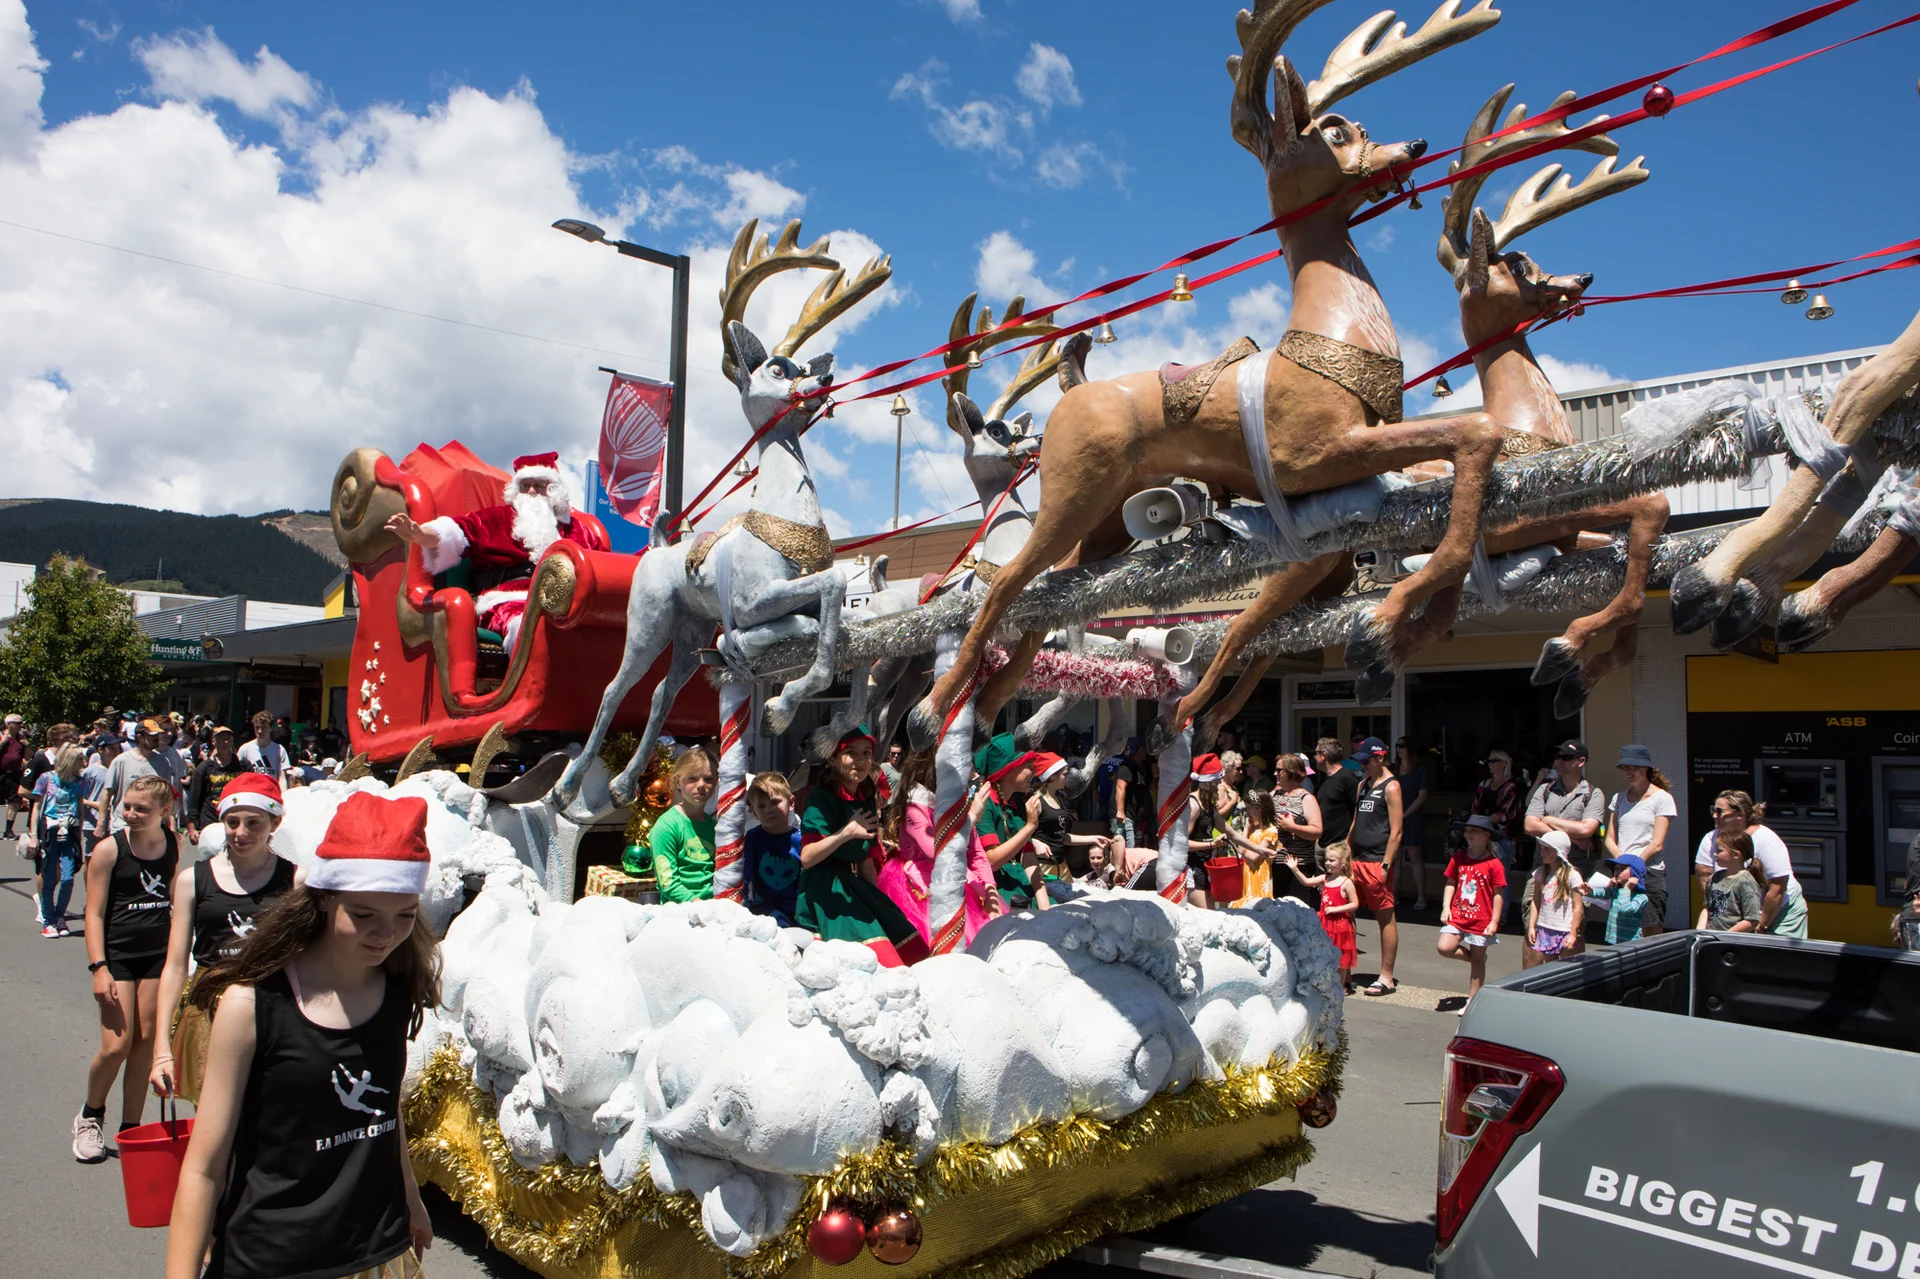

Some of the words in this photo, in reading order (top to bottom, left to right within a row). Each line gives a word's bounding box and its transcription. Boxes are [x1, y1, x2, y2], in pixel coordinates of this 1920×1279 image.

[150, 643, 188, 655] Hunting
[1784, 732, 1812, 743] ATM
[1360, 802, 1372, 810] AIG
[334, 1127, 366, 1147] DANCE
[1584, 1165, 1838, 1255] BIGGEST
